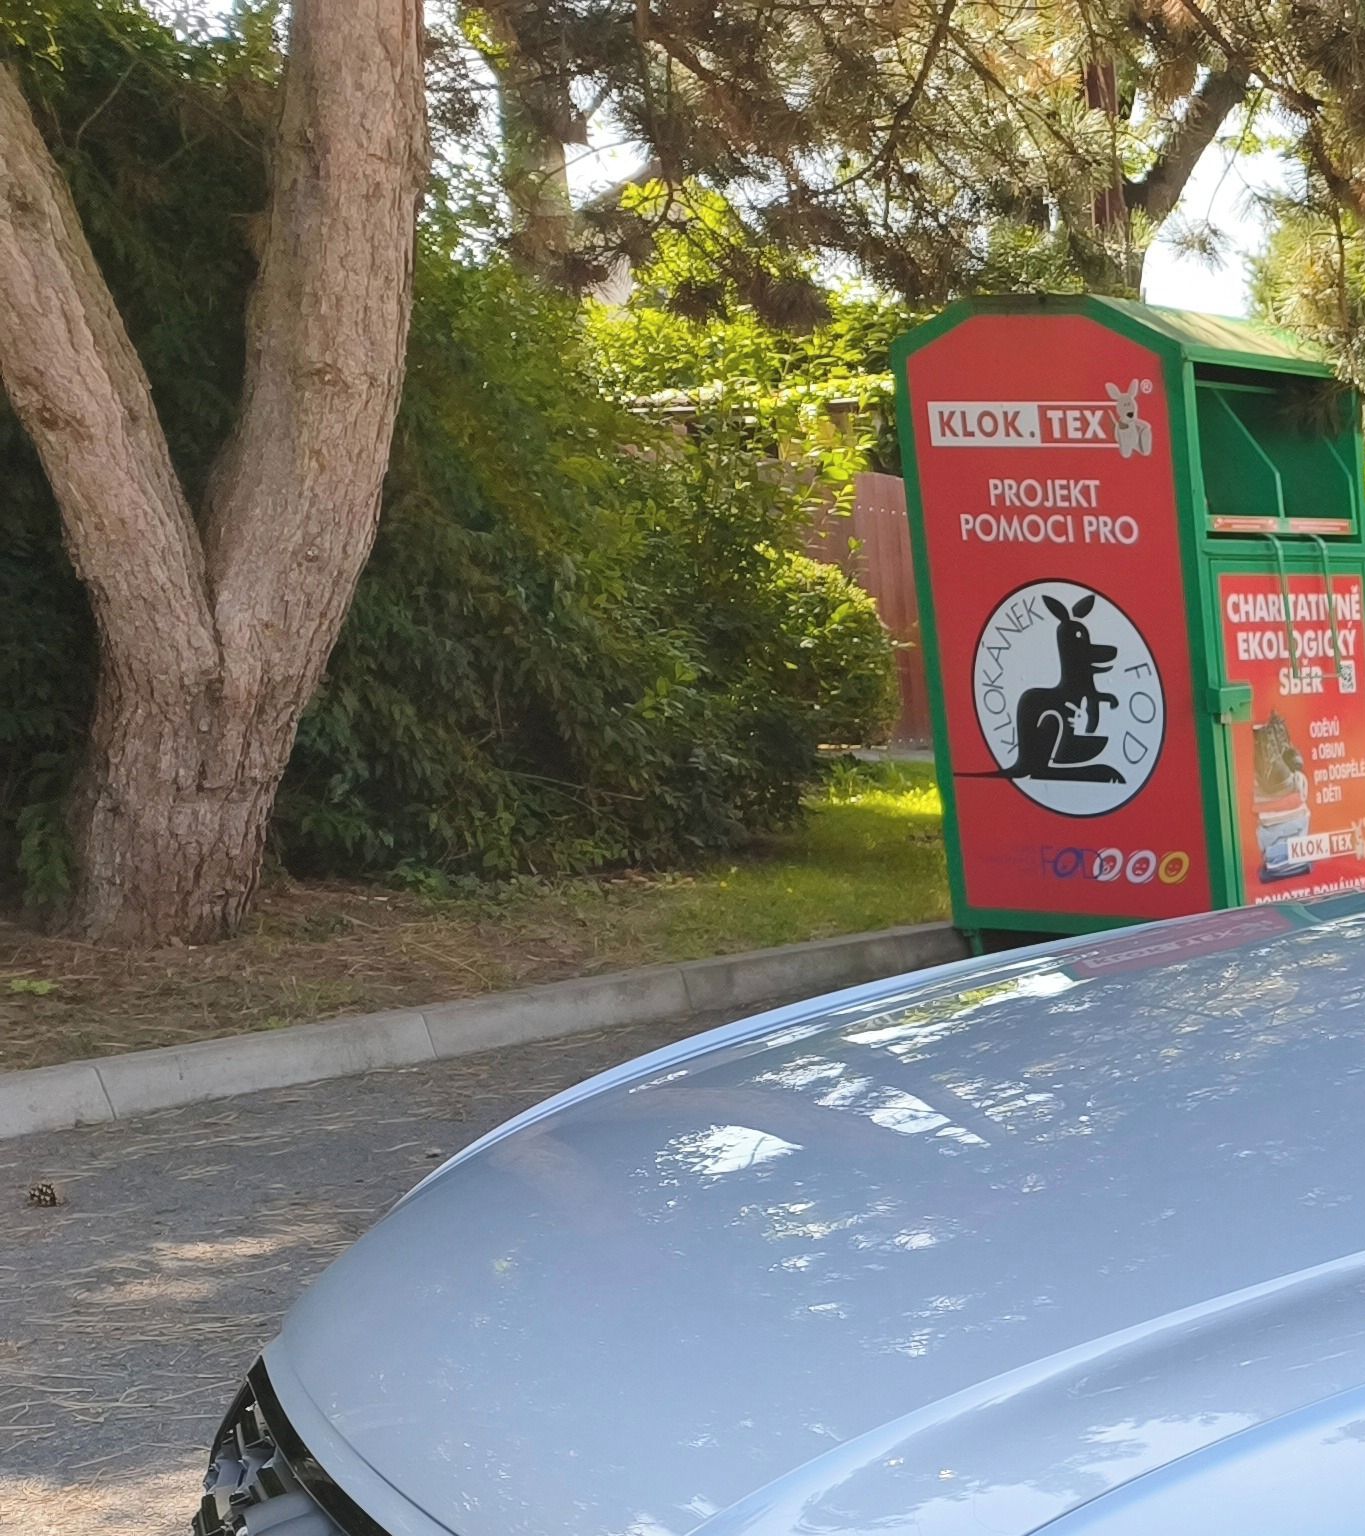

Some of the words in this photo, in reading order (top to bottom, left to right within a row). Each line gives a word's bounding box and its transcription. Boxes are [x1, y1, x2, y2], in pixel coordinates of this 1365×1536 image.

[1046, 409, 1107, 439] TEX
[988, 478, 1100, 507] PROJEKT
[960, 513, 1075, 543] POMOCI
[1083, 515, 1139, 544] PRO
[982, 596, 1044, 755] KLOKÁNEK
[1123, 662, 1157, 765] FOD
[1318, 741, 1346, 759] OBUVI
[1330, 832, 1353, 852] TEX
